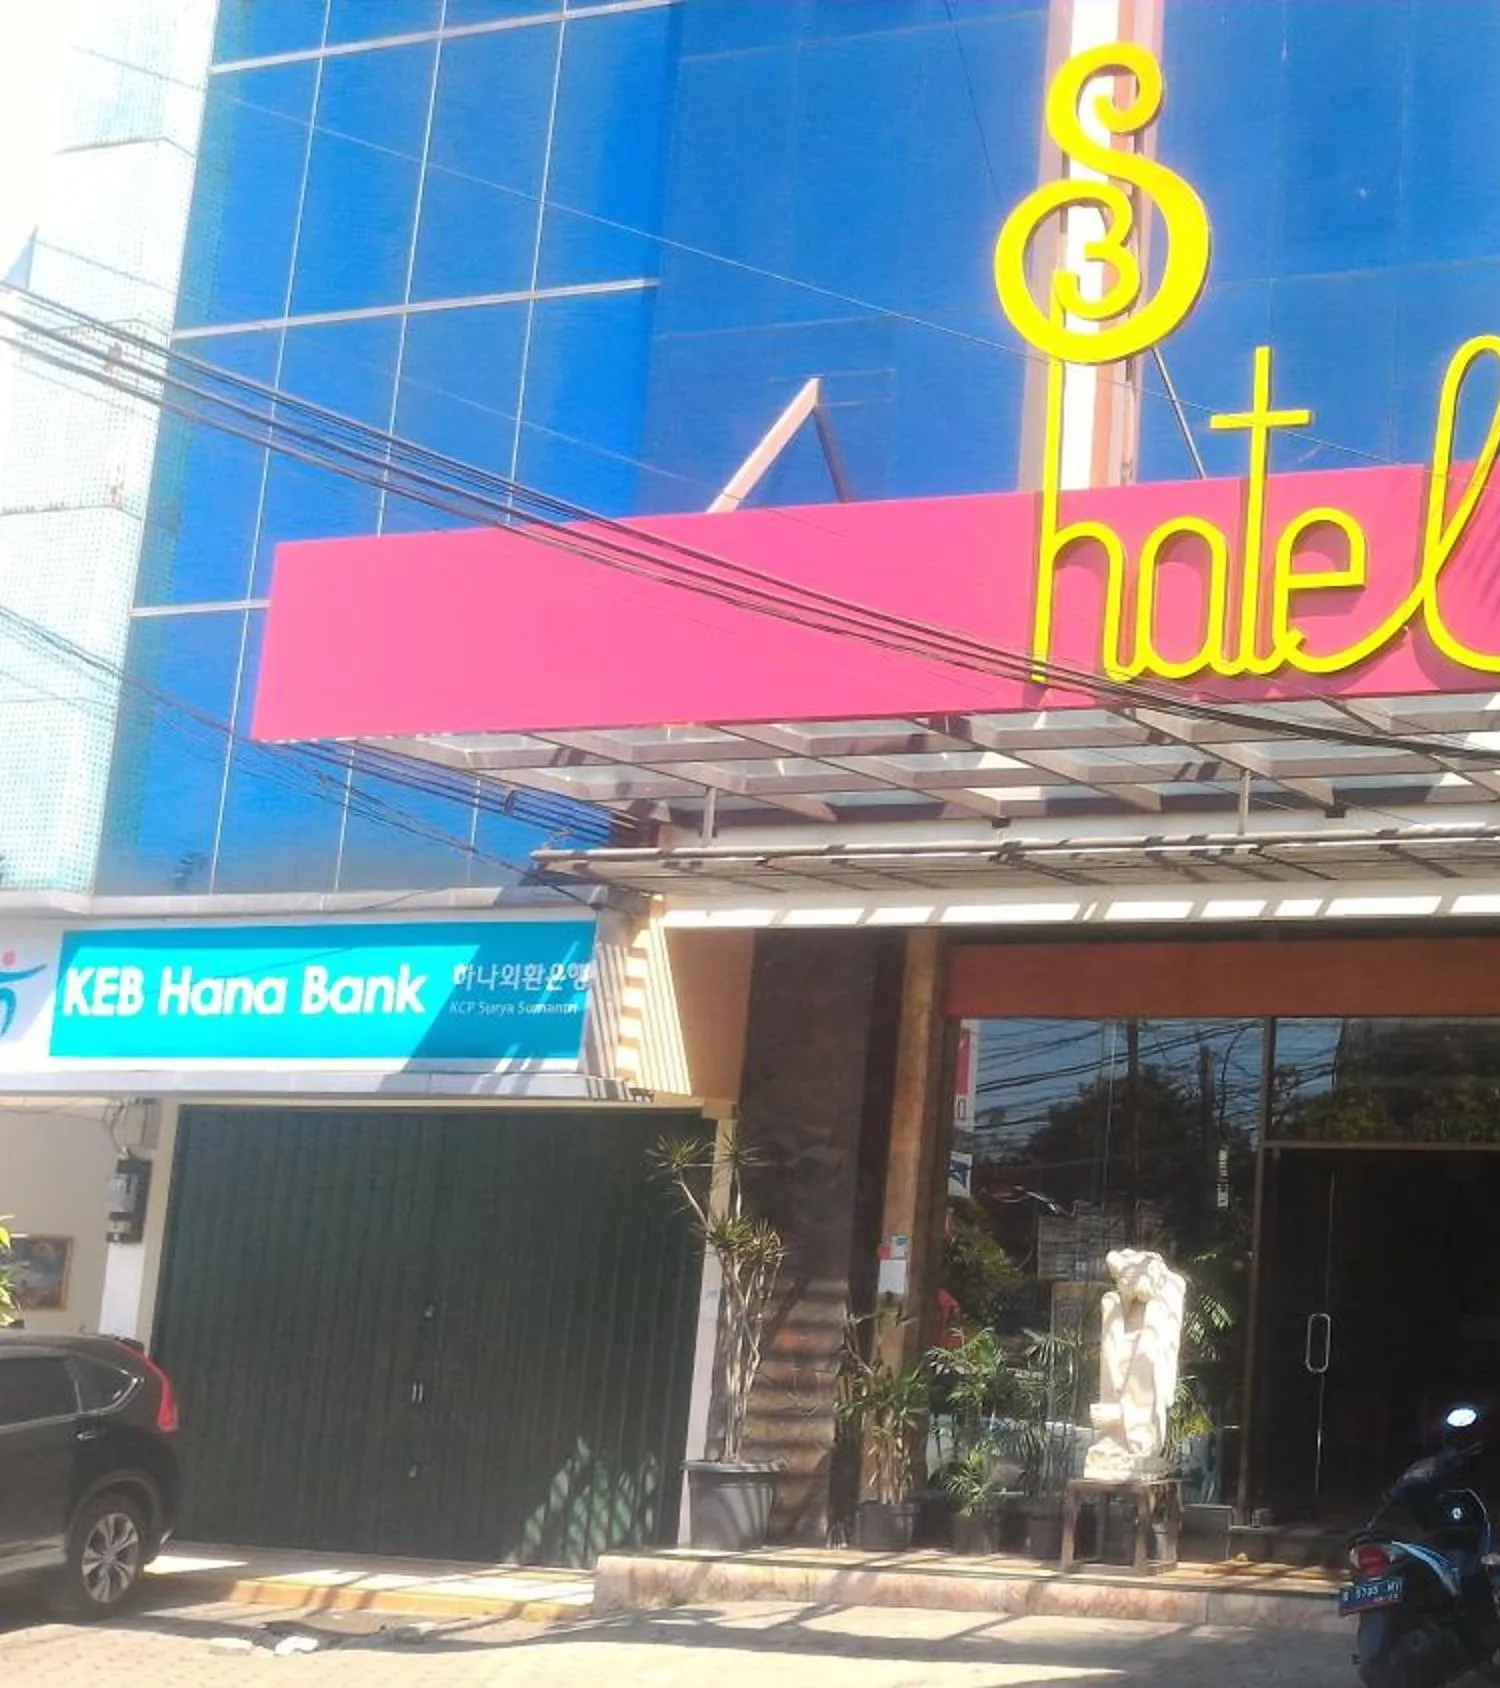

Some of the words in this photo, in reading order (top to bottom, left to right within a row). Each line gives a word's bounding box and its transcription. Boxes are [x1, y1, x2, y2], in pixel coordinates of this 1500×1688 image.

[62, 966, 144, 1017] KEB
[157, 964, 288, 1017] Hana
[300, 962, 428, 1016] Bank
[453, 962, 592, 992] 하나외환은행
